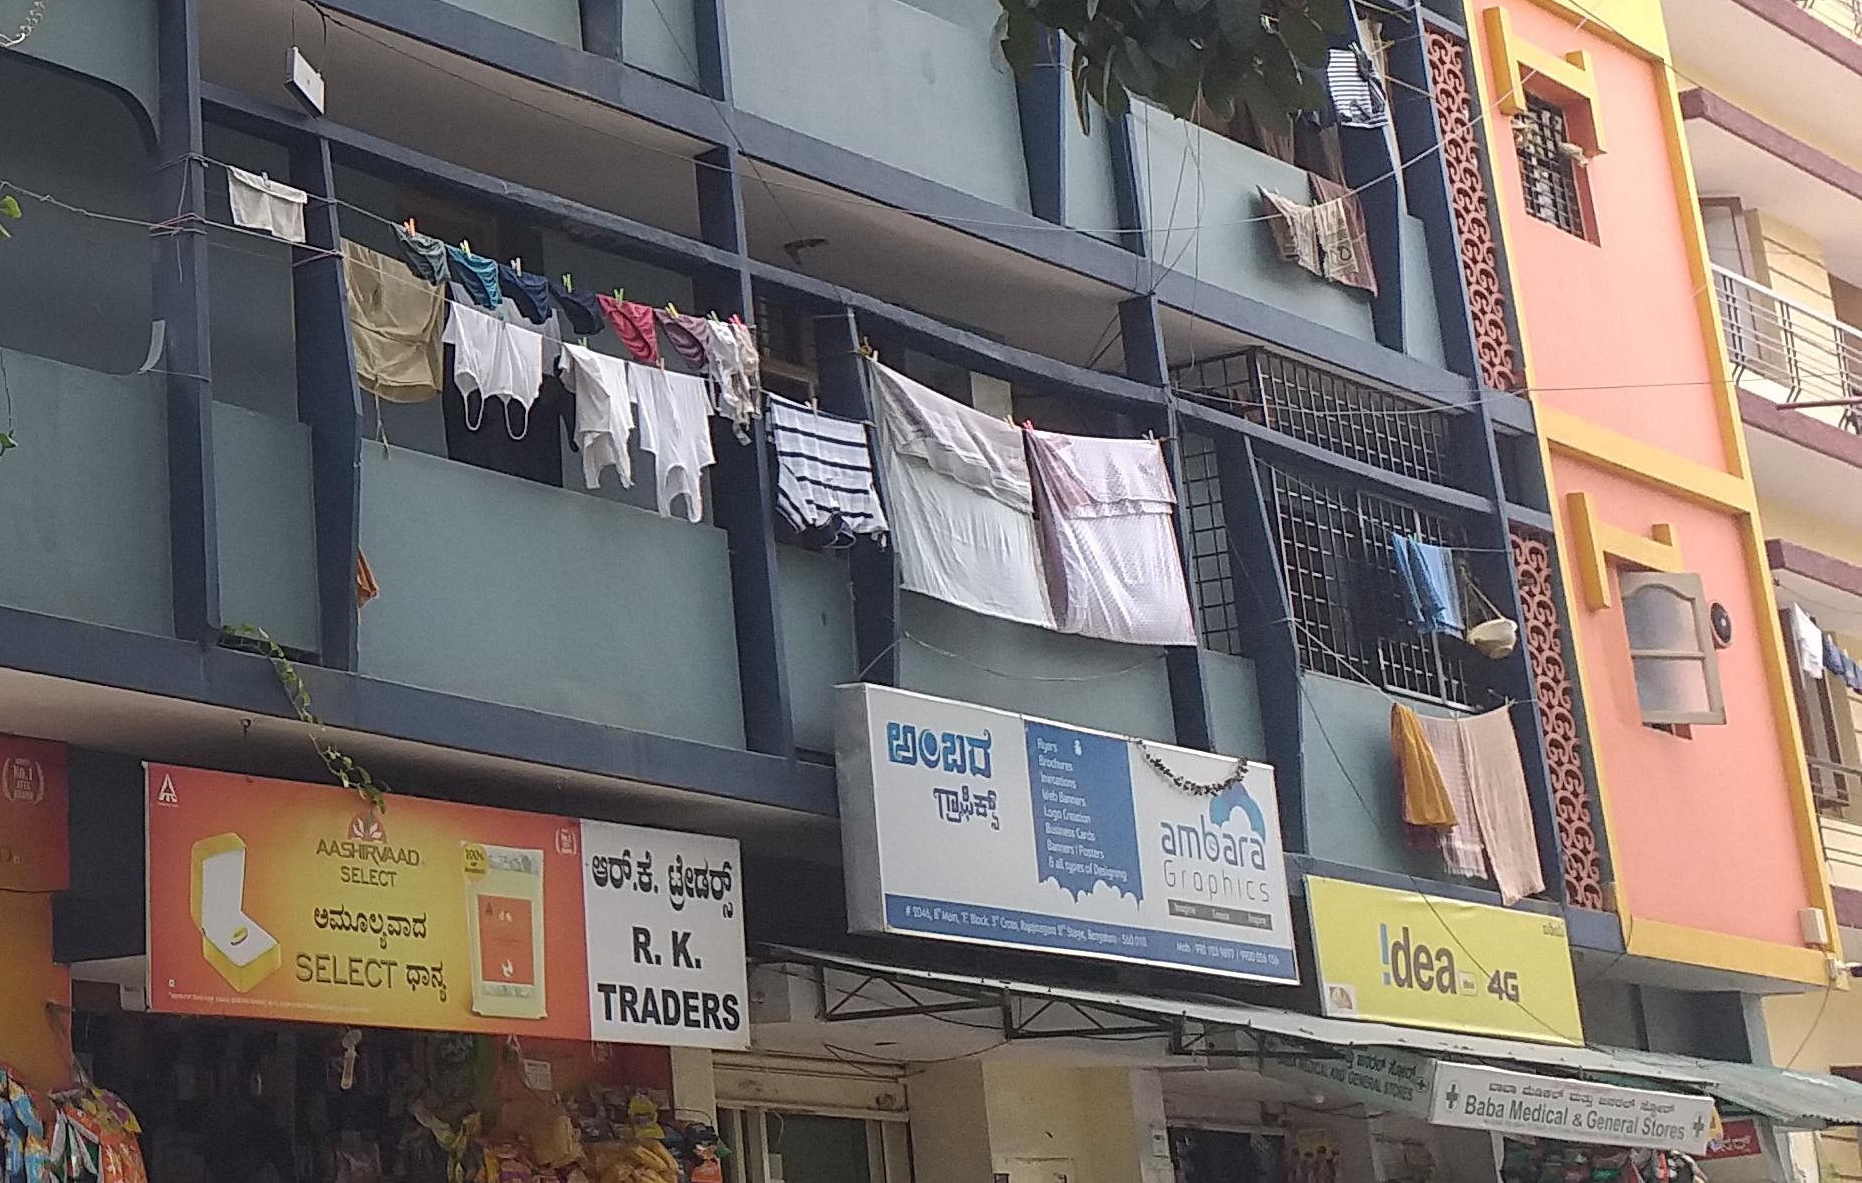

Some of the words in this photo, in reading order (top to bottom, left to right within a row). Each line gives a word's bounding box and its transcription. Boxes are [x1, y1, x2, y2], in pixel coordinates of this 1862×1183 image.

[887, 721, 992, 778] ಅಂಬರ
[316, 838, 420, 866] AASHIRVAAD
[1160, 814, 1266, 870] ambara
[340, 867, 397, 887] SELECT
[668, 854, 734, 919] ಟ್ರೇಡರ್ಸ್
[314, 904, 427, 949] ಅಮೂಲ್ಯವಾದ
[632, 926, 661, 965] R.
[671, 930, 702, 969] K.
[296, 953, 398, 988] SELECT
[406, 961, 447, 1003] ಧಾನ್ಯ
[1487, 969, 1520, 1003] 4G
[597, 983, 740, 1031] TRADERS
[1464, 1094, 1505, 1118] Baba
[1509, 1099, 1569, 1126] Medical
[1572, 1113, 1583, 1126] &
[1586, 1110, 1639, 1134] General
[1641, 1117, 1686, 1140] Stores
